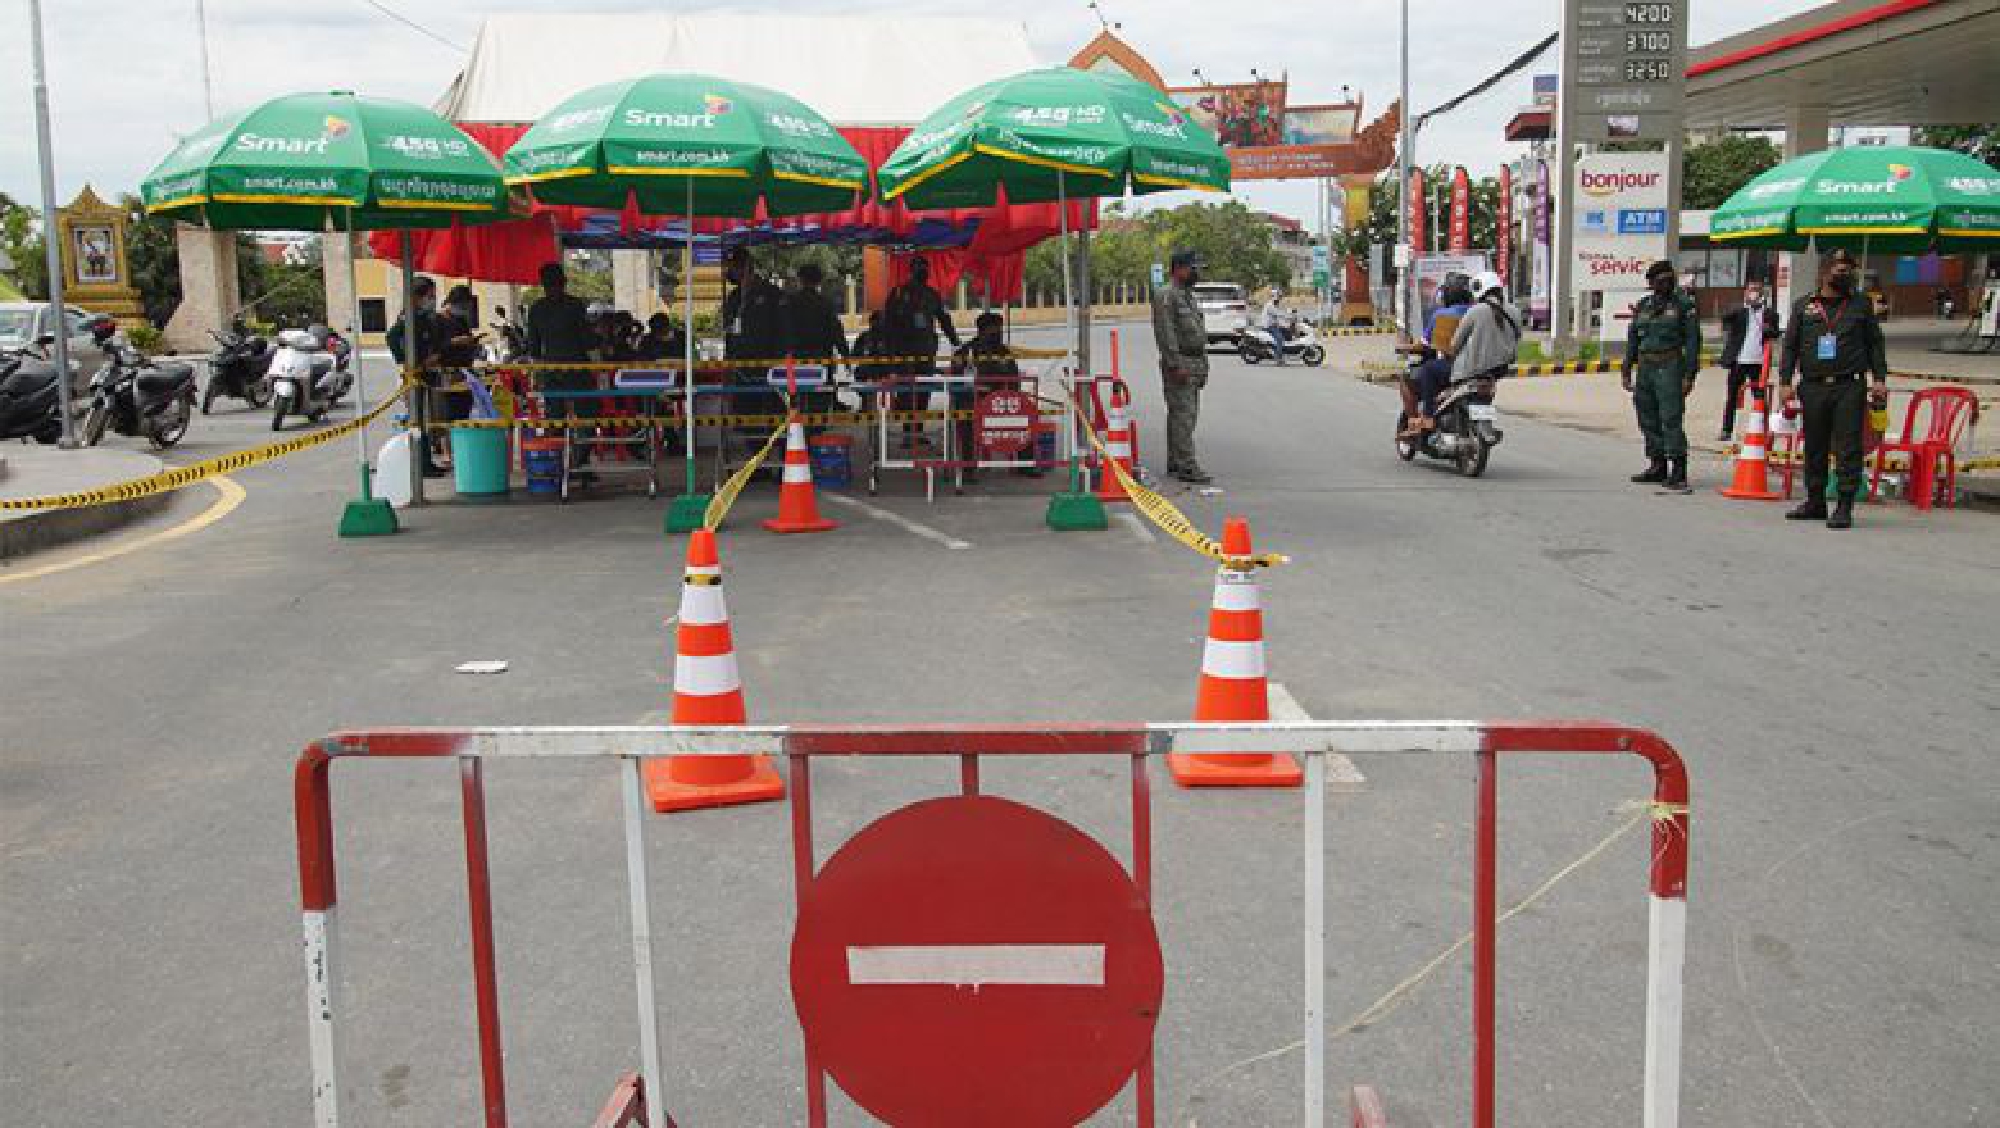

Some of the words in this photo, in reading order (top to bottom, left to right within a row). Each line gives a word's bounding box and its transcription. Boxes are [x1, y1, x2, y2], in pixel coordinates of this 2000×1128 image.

[1627, 4, 1670, 22] 4200
[1627, 61, 1668, 79] 3250
[625, 109, 716, 128] Smart
[236, 132, 329, 155] Smart
[1581, 168, 1660, 192] bonjour
[1817, 178, 1897, 194] Smart
[1625, 211, 1663, 225] ATM
[1591, 256, 1647, 276] servic
